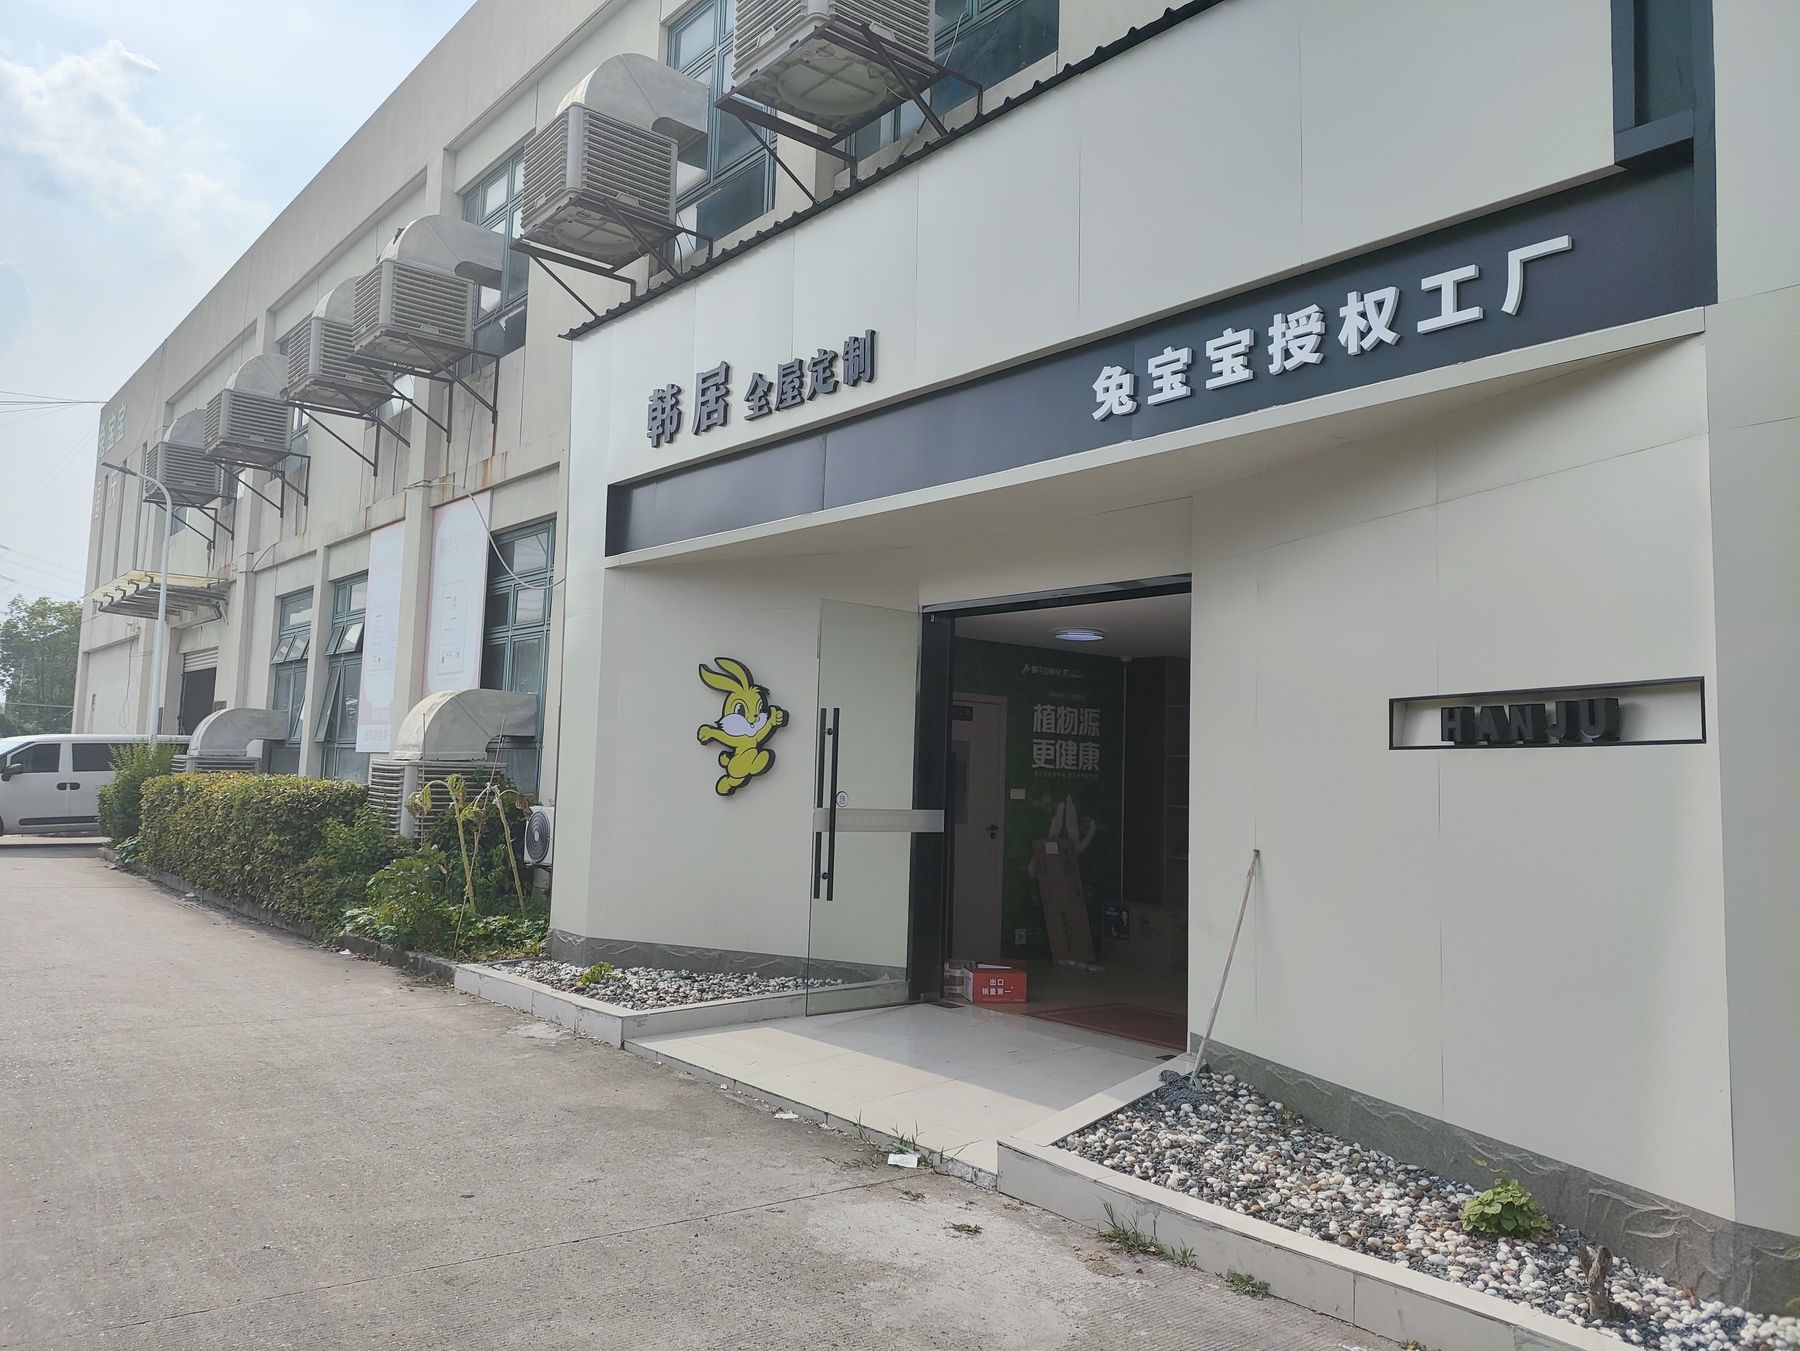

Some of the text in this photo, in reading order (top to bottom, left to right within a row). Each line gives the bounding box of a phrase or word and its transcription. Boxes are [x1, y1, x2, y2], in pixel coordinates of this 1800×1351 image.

[1091, 234, 1573, 420] 兔宝宝授权工厂
[647, 329, 876, 448] 韩居 全屋定制
[1032, 703, 1101, 737] 植物源
[1441, 698, 1620, 745] HANJU
[1032, 738, 1101, 771] 更健康
[989, 978, 1004, 986] 出口
